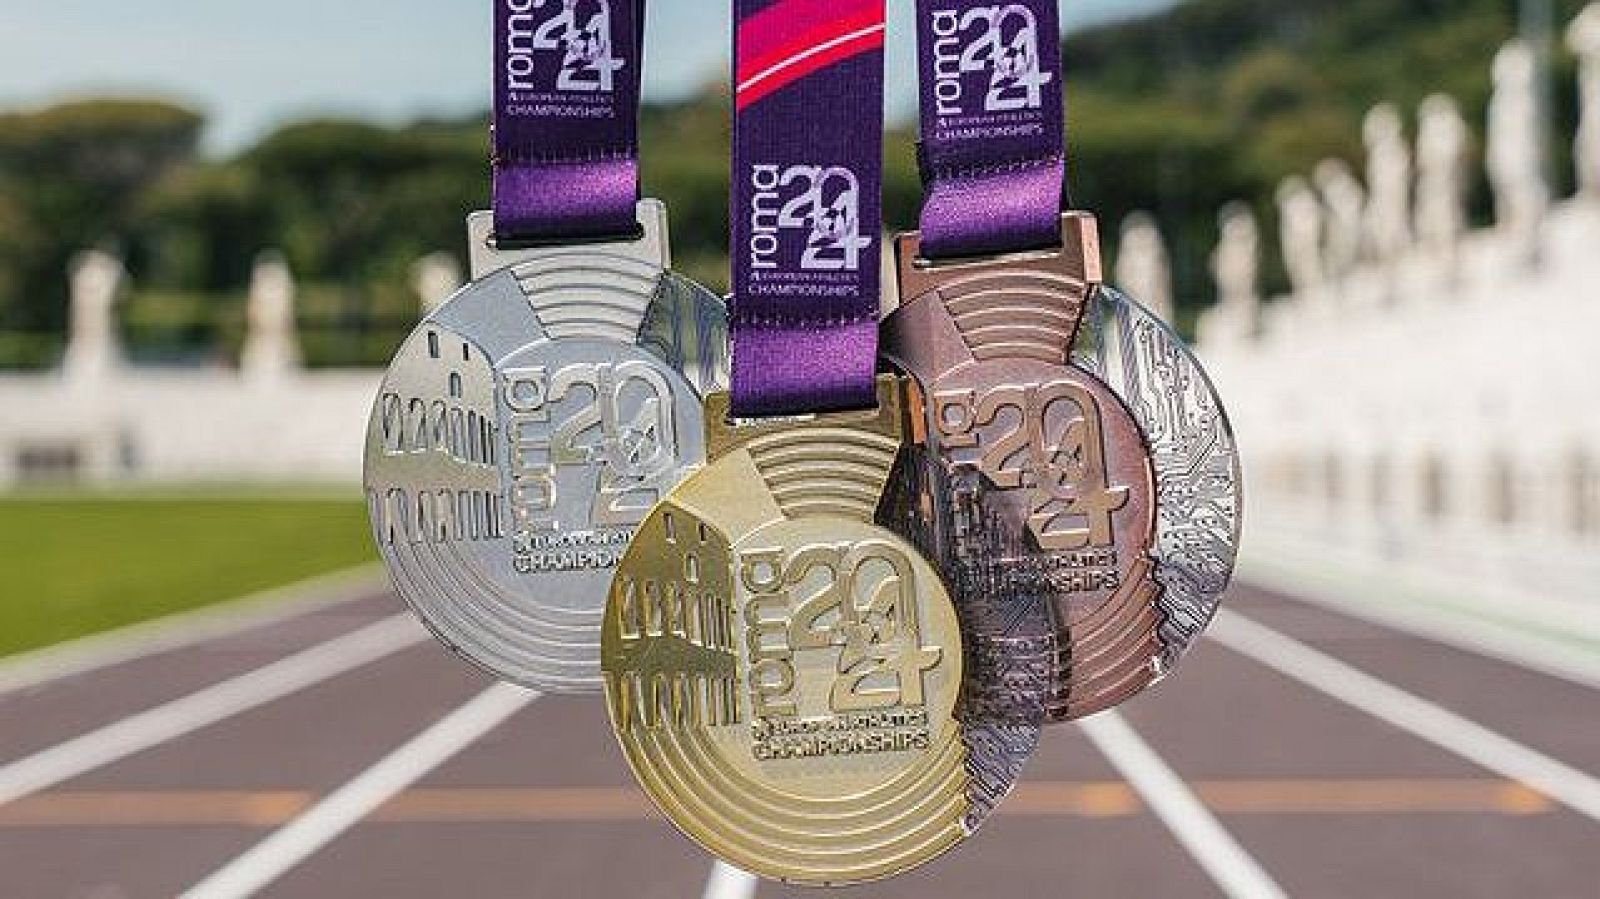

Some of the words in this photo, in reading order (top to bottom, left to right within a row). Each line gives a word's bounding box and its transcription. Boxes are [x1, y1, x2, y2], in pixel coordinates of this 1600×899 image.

[933, 9, 962, 115] roma
[751, 165, 779, 268] roma
[503, 366, 558, 531] roma
[741, 546, 796, 718] roma
